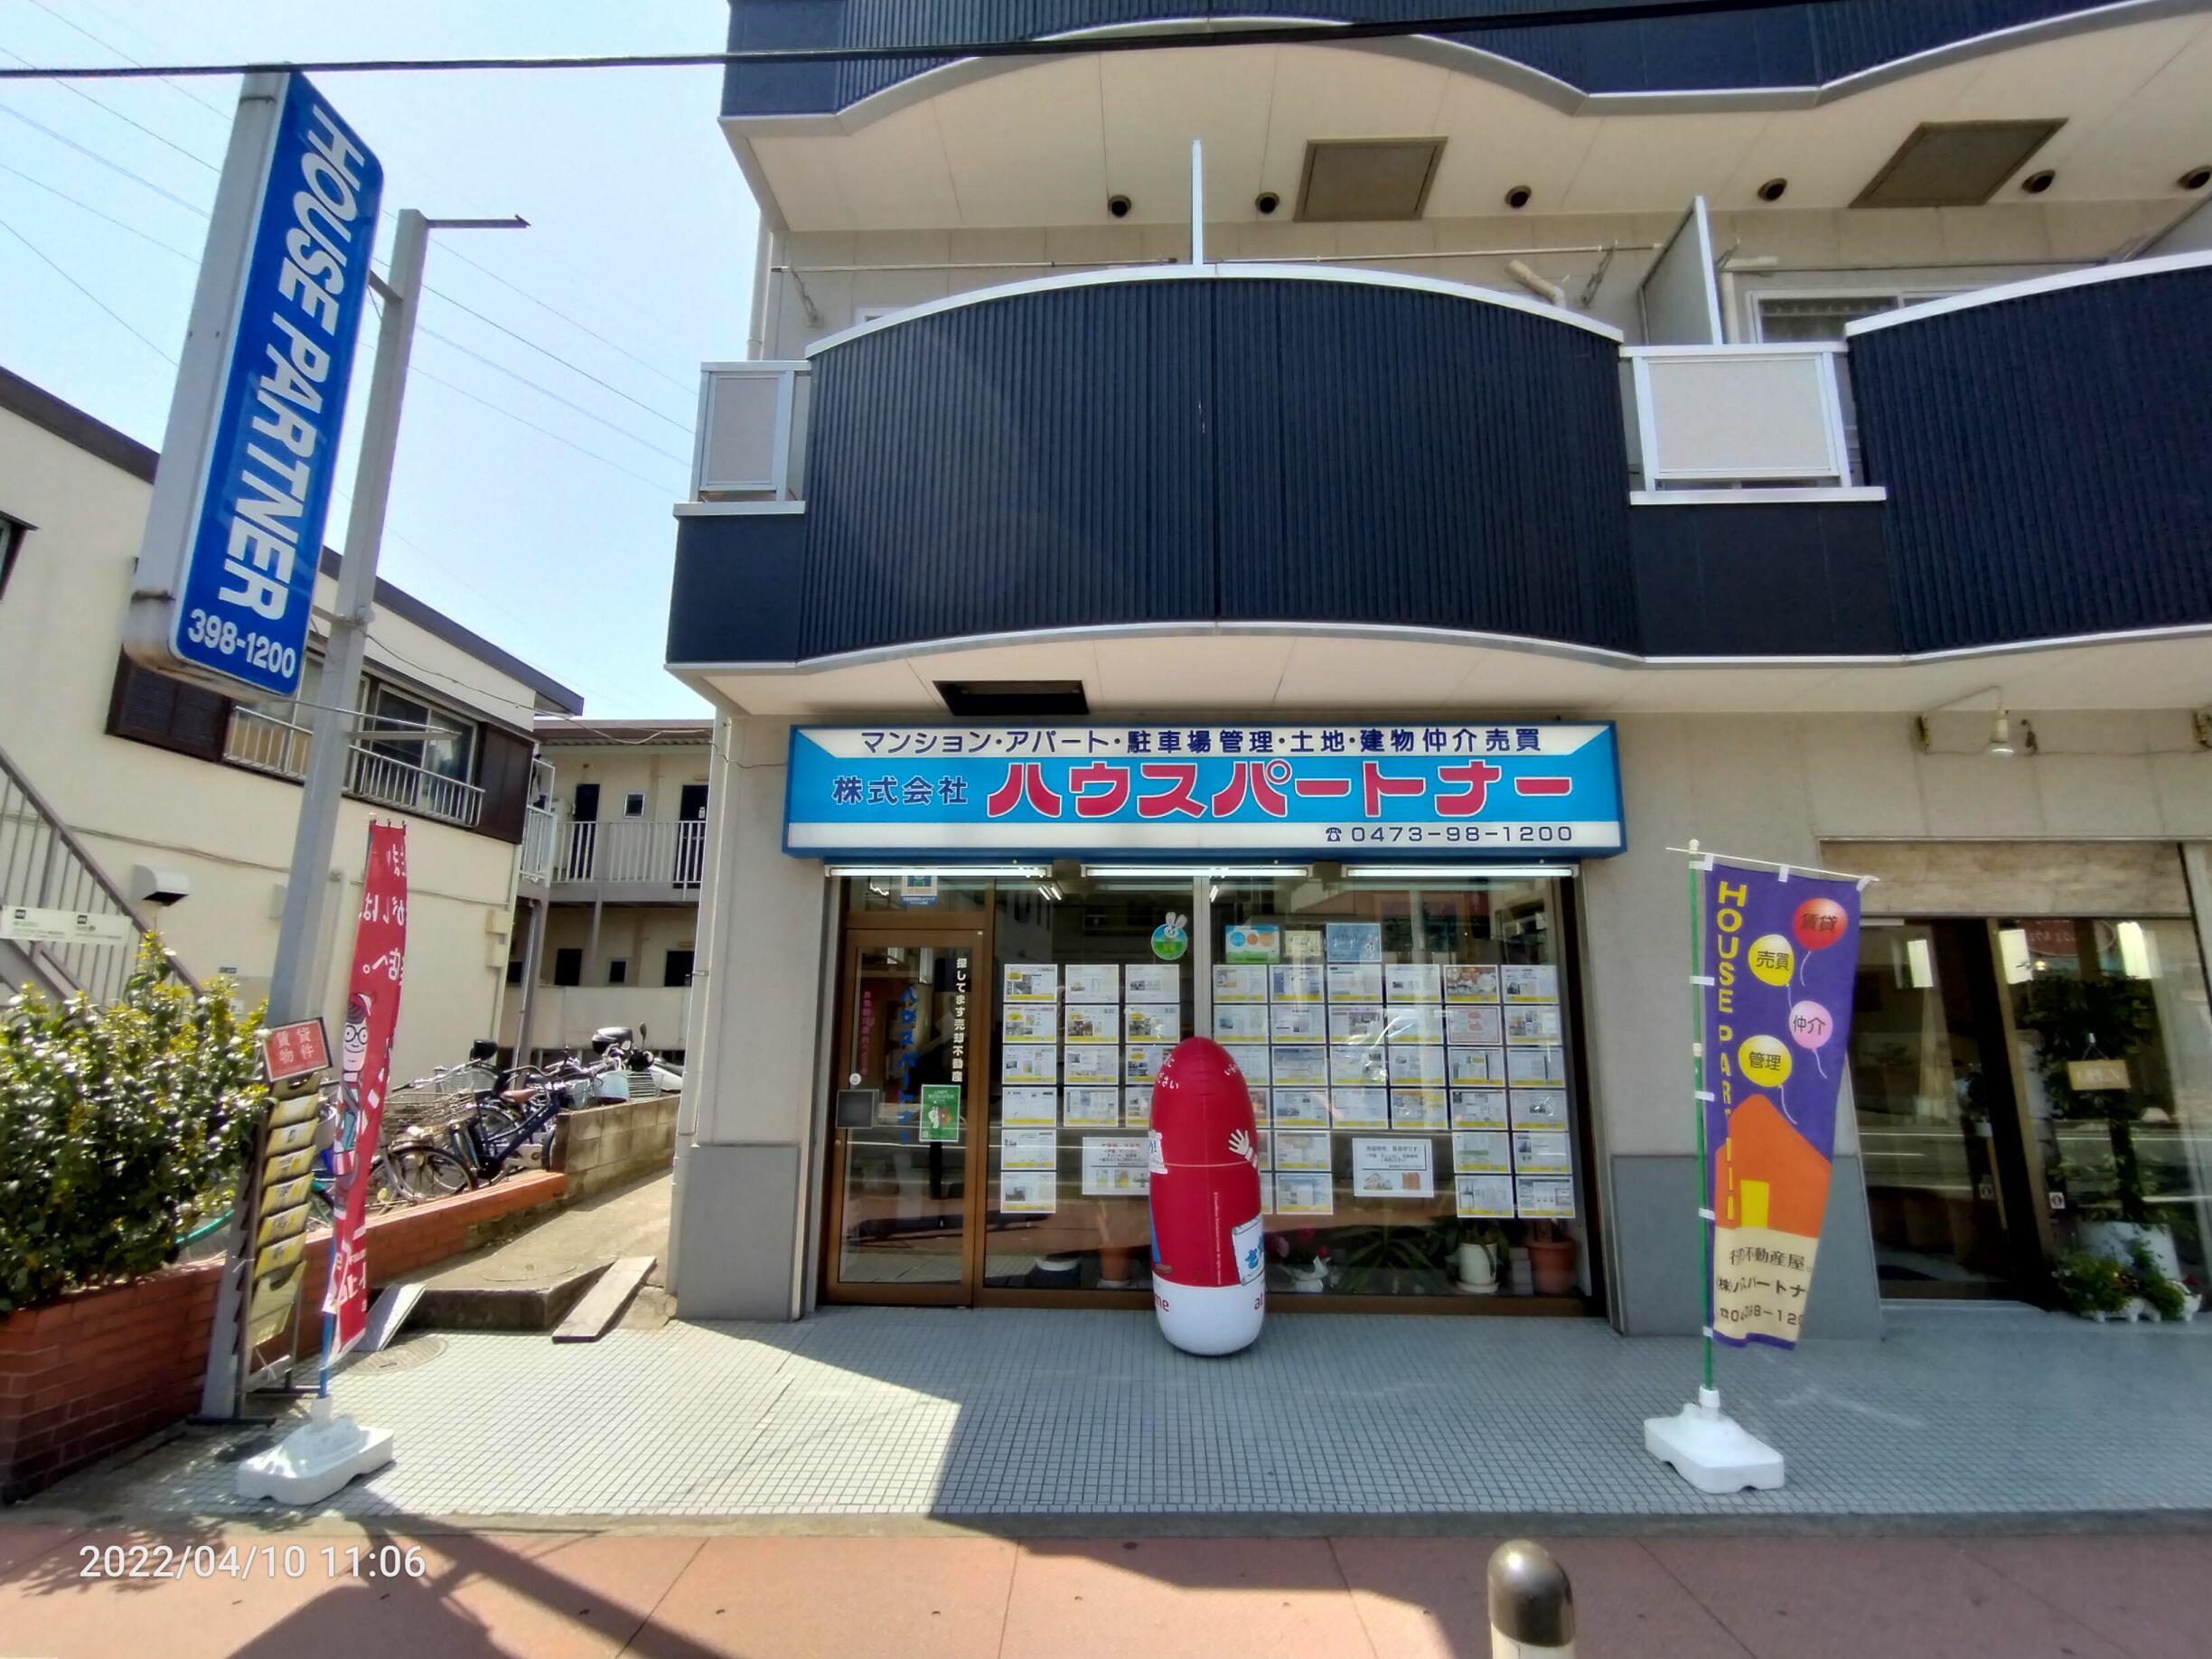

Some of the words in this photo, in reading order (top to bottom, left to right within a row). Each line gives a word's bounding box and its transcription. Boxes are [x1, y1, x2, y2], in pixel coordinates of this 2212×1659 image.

[278, 104, 364, 335] HOUSE
[219, 313, 331, 620] PARTNER
[187, 608, 296, 679] 398-1200
[832, 775, 969, 805] 株式会社
[987, 759, 1572, 819] ハウスパートナー
[1801, 914, 1838, 933] 賃貸
[1717, 881, 1747, 1014] HOUSE
[1757, 950, 1790, 971] 売買
[1793, 1015, 1825, 1036] 仲介
[280, 1044, 314, 1064] 物件
[1748, 1052, 1781, 1072] 管理
